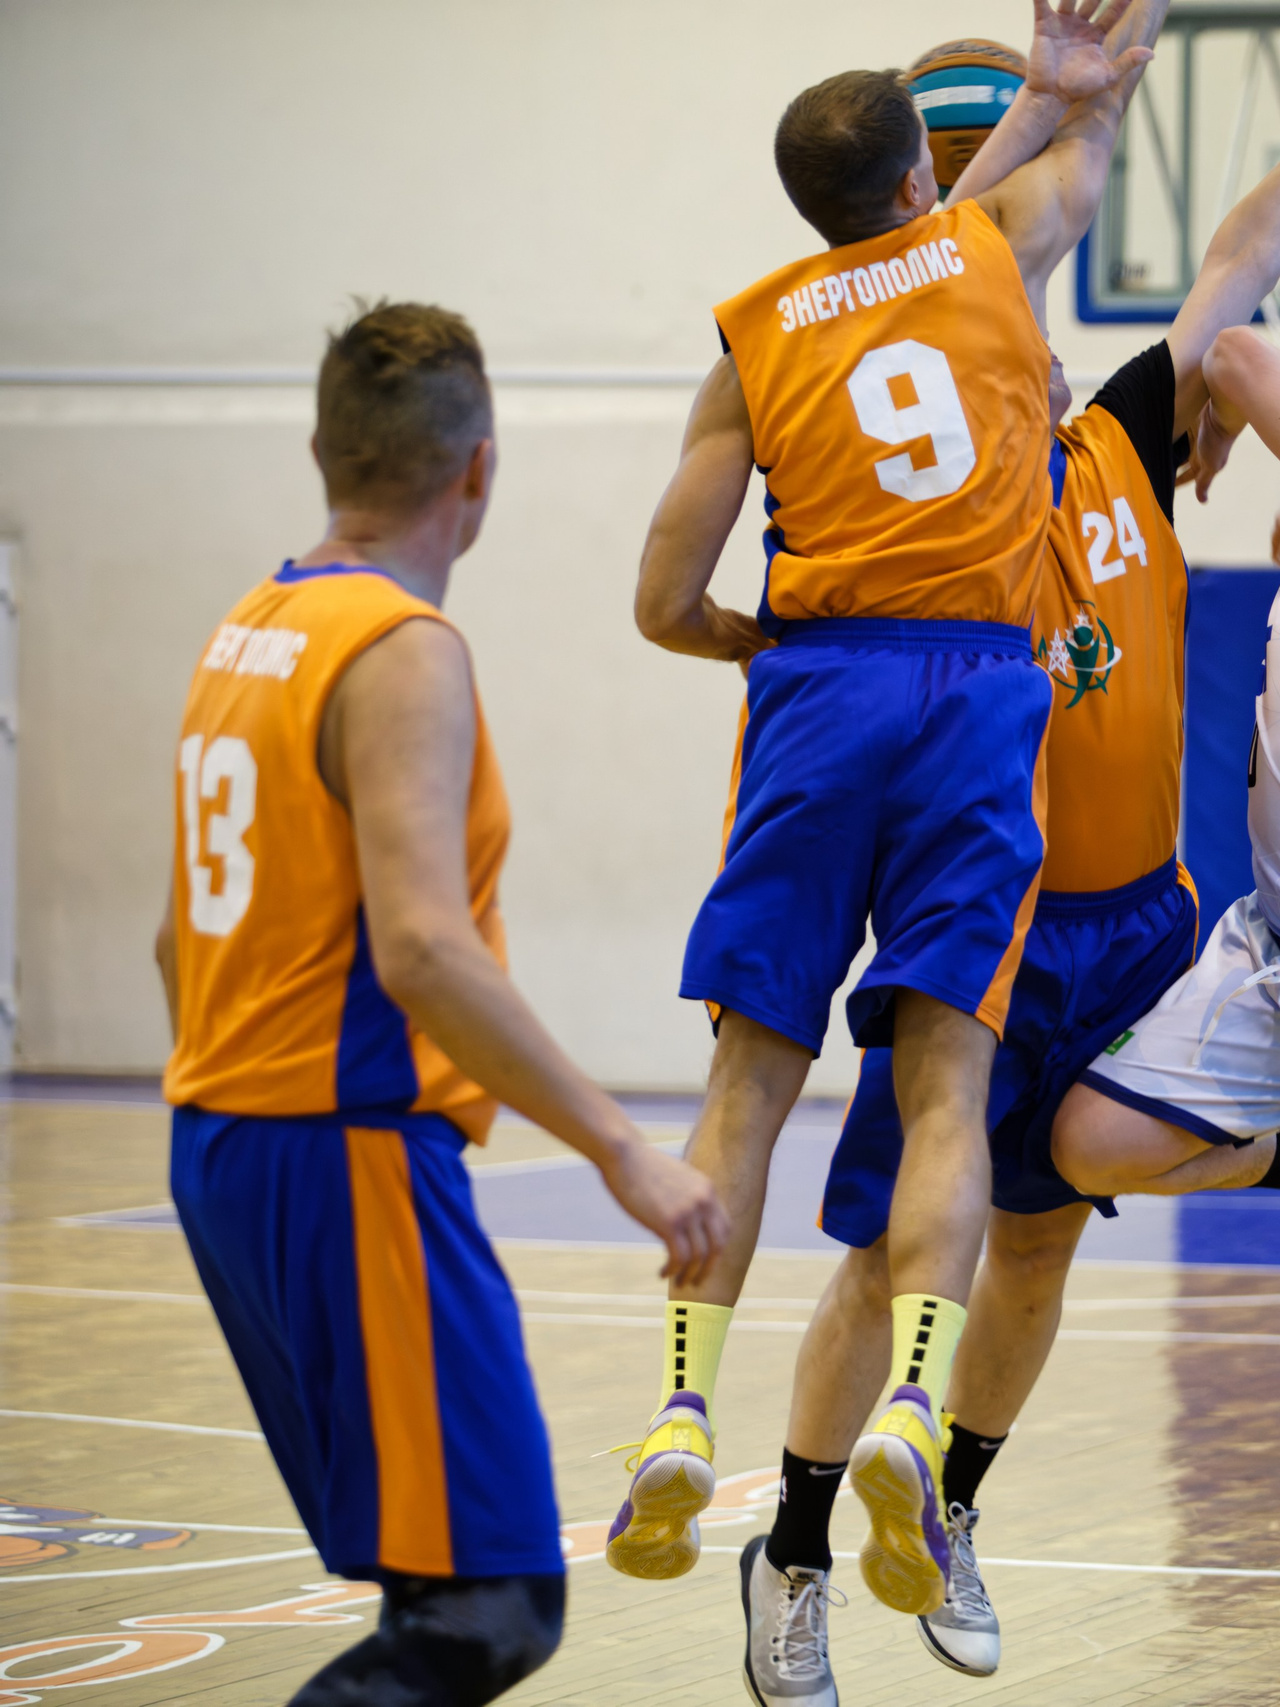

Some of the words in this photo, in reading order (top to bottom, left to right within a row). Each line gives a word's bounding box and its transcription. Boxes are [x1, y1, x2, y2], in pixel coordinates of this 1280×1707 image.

[777, 237, 965, 333] ЭНЕРГОПОЛИС
[846, 338, 977, 503] 9
[1082, 496, 1148, 585] 24
[180, 733, 257, 937] 13
